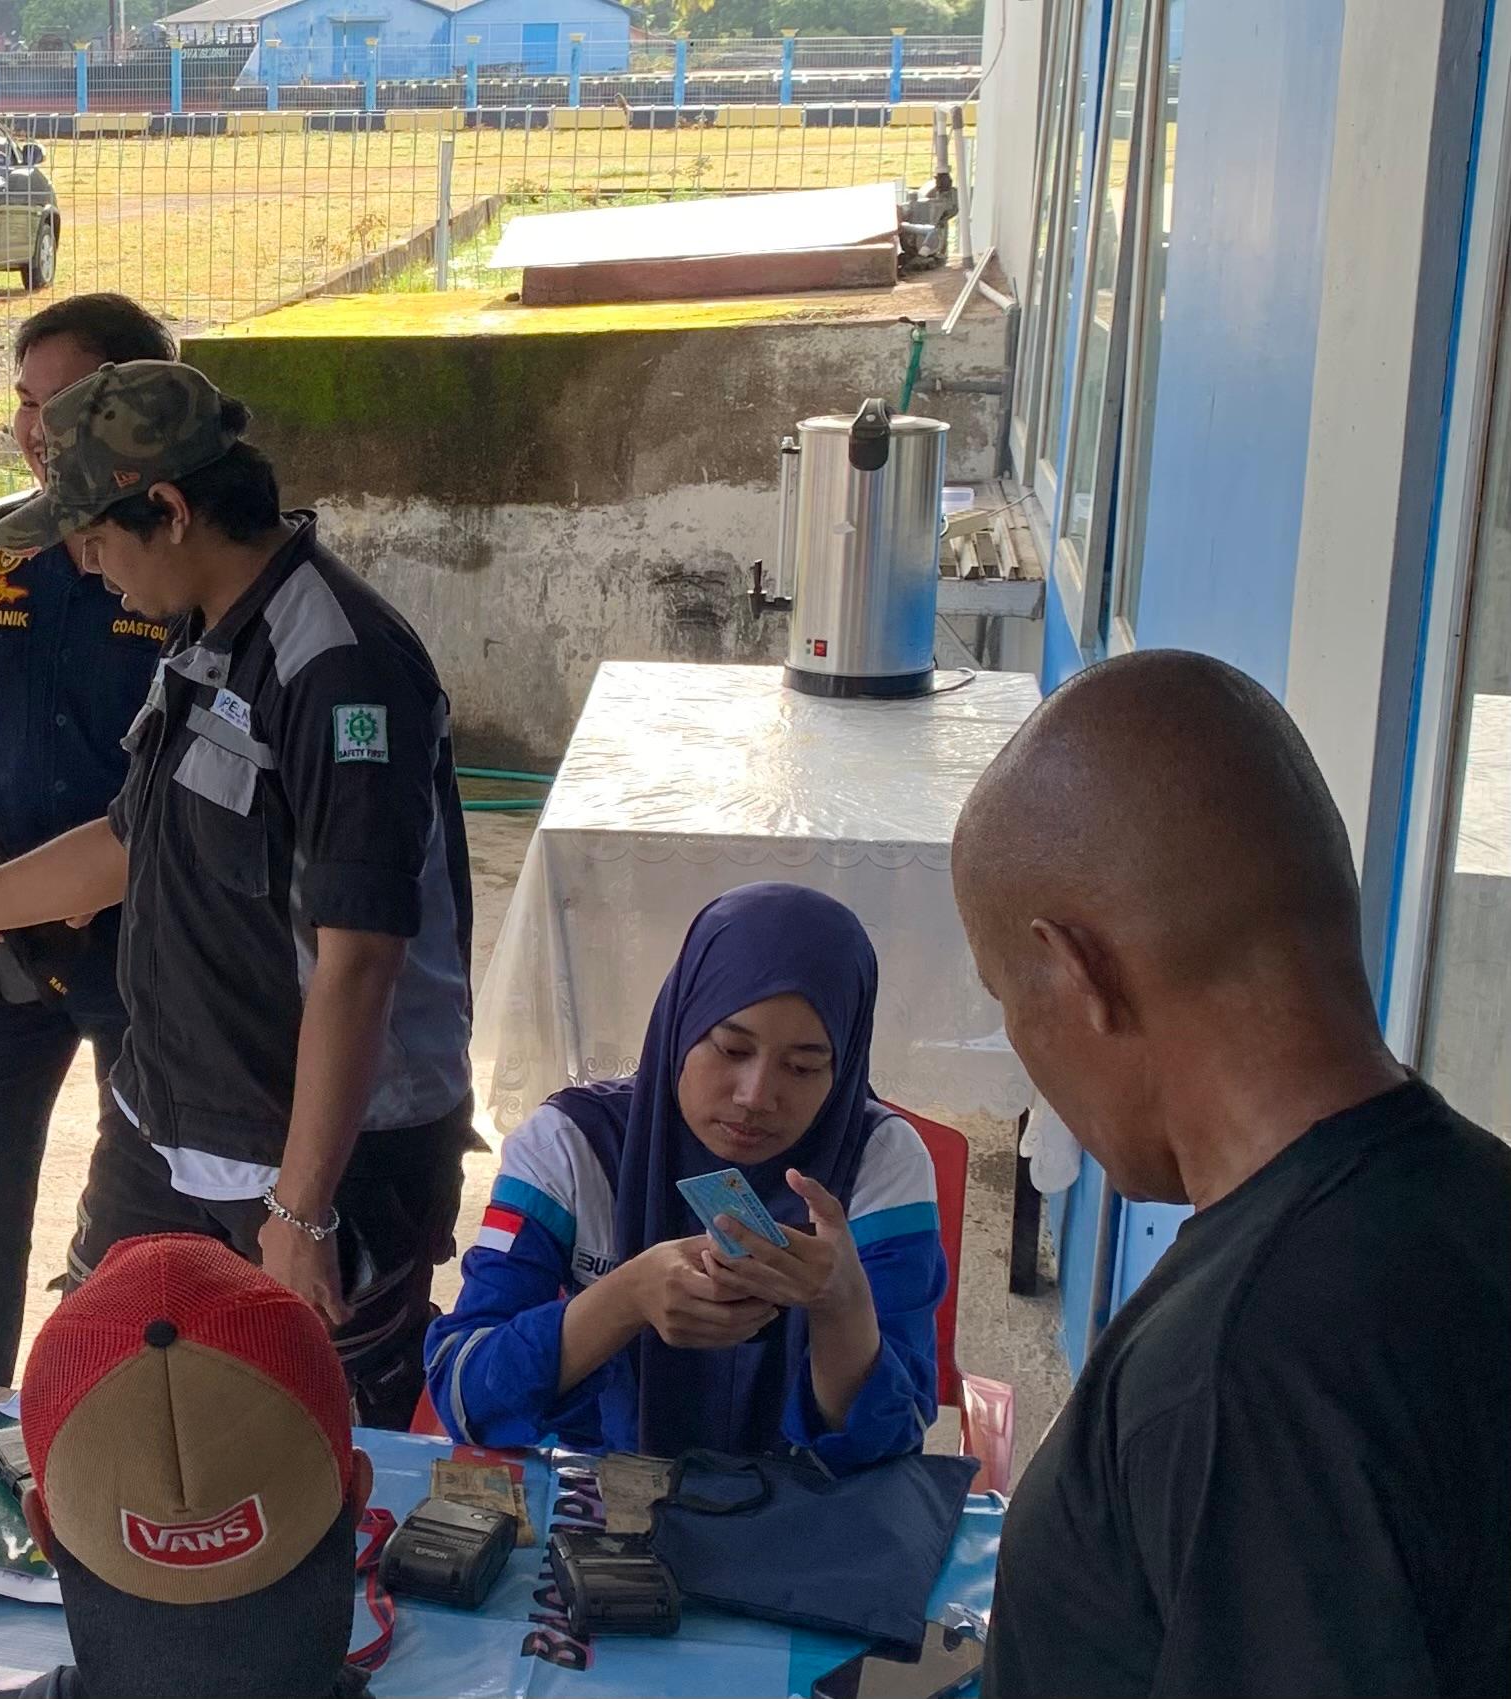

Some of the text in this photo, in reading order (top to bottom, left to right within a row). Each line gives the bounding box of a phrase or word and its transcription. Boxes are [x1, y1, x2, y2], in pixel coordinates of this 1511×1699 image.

[339, 748, 386, 759] SAFETY FIRST
[137, 1509, 251, 1554] VANS
[414, 1547, 448, 1561] EPSON
